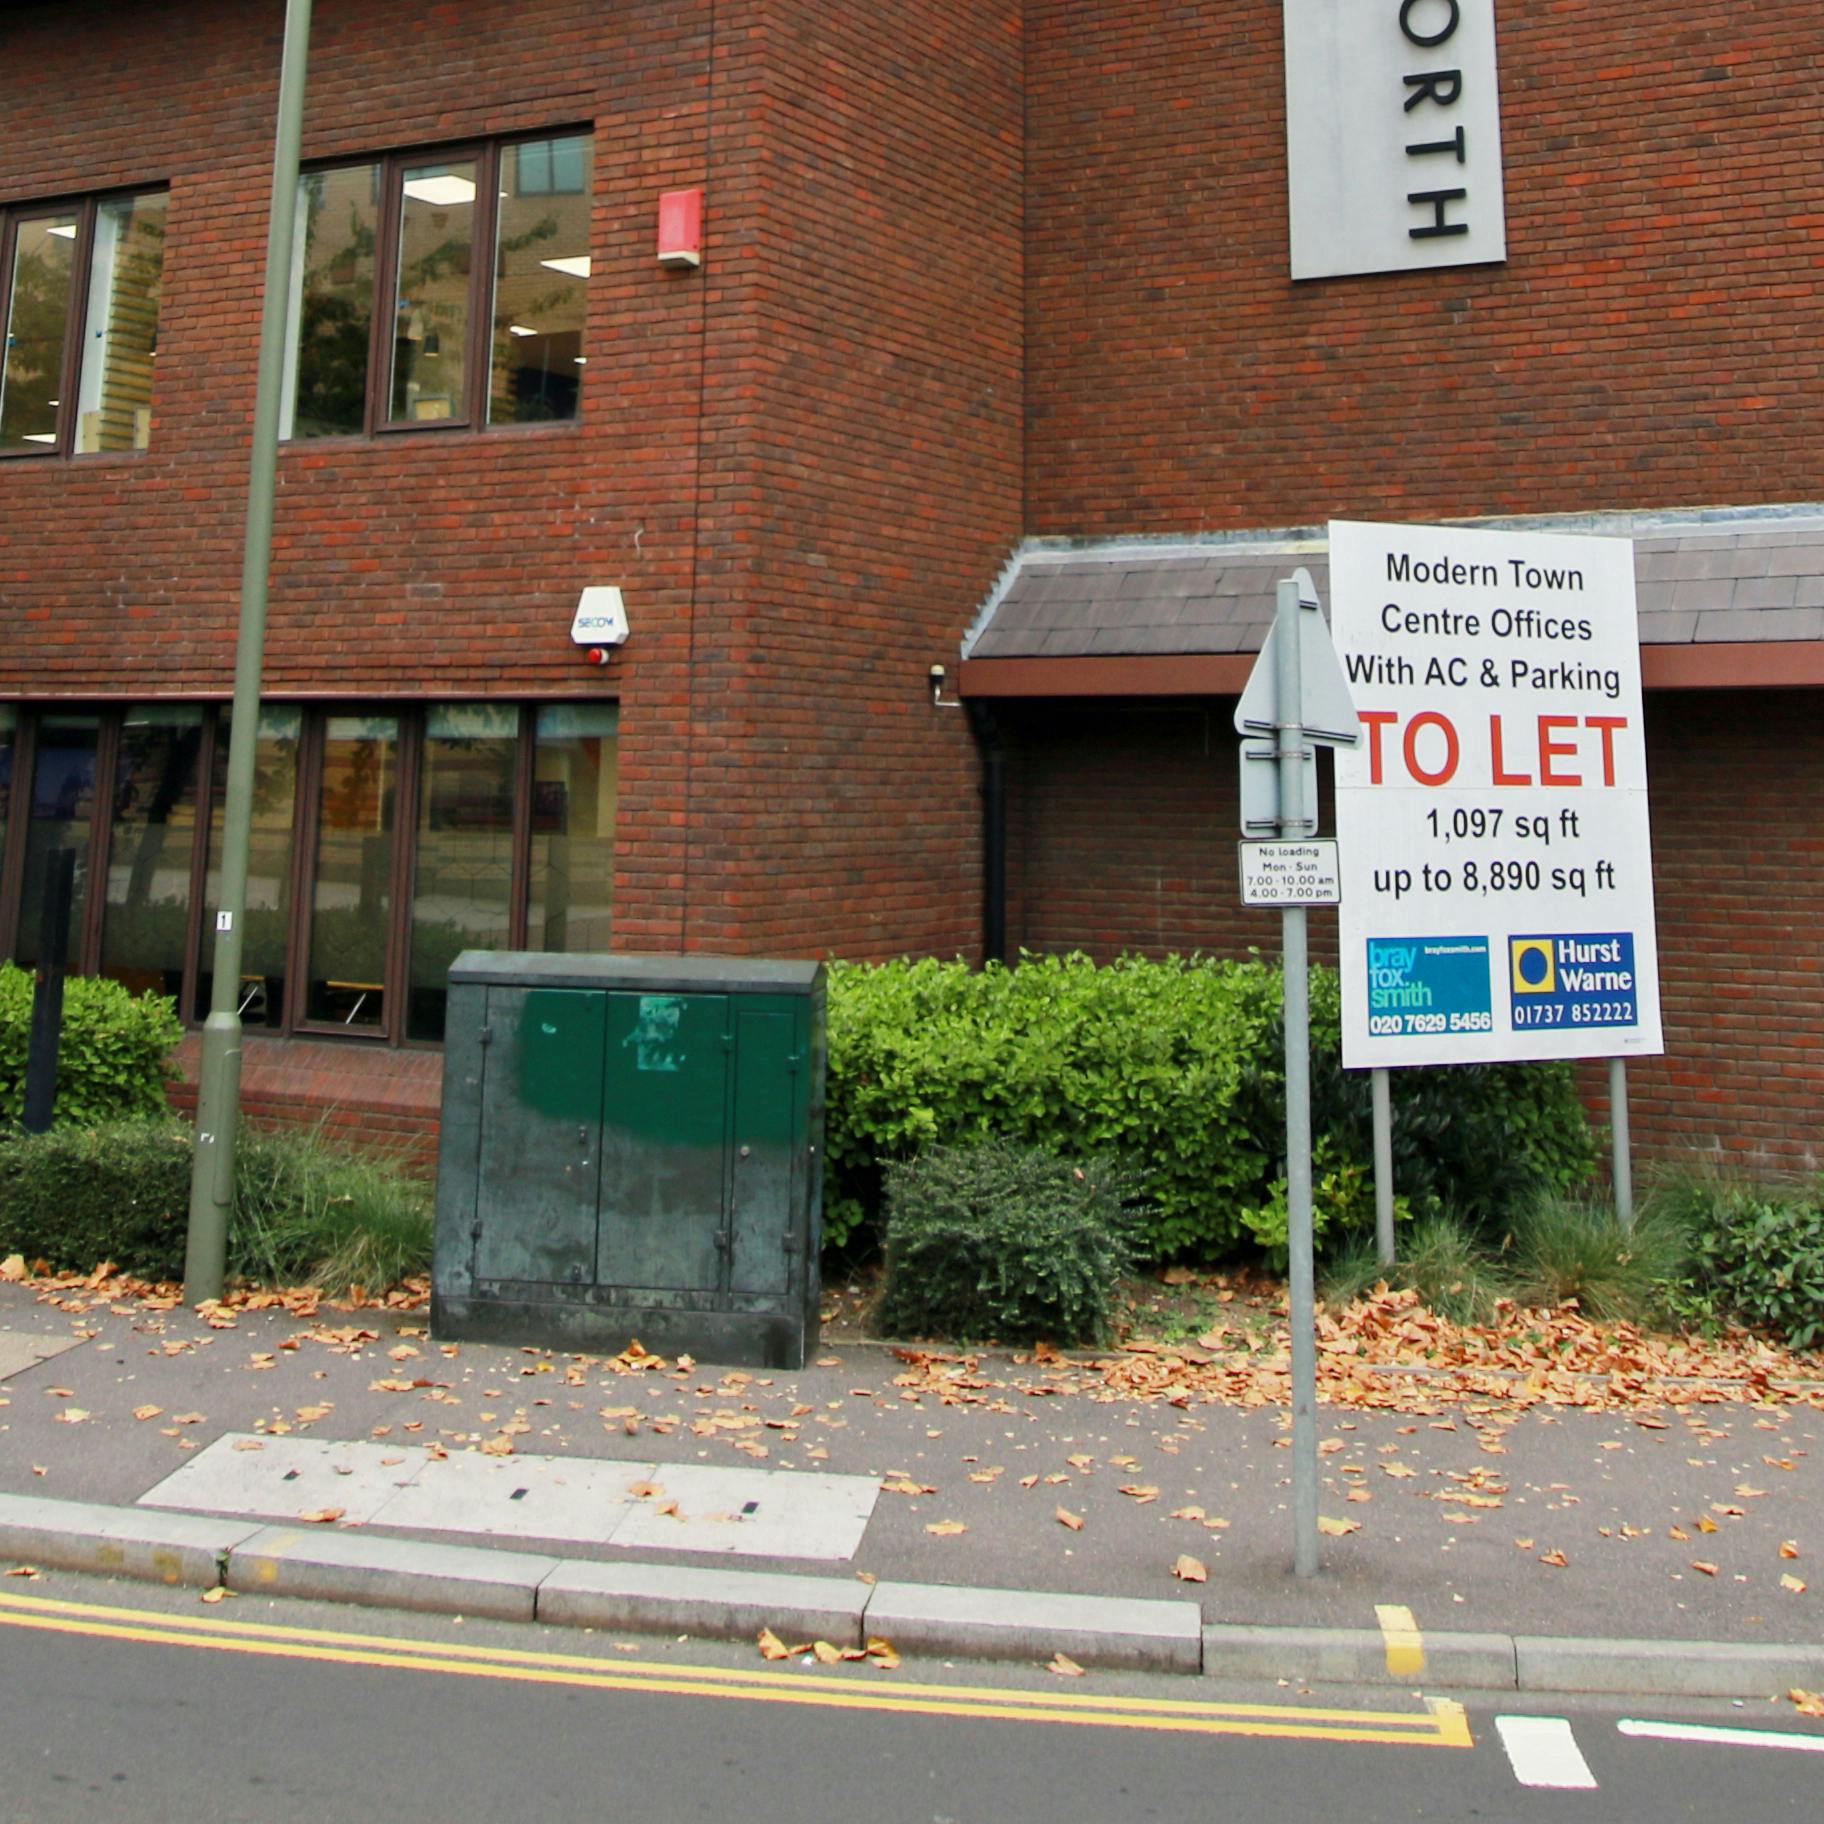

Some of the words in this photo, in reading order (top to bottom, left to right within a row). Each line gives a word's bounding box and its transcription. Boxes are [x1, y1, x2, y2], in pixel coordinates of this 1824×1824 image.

[1387, 554, 1497, 586] Modern
[1509, 560, 1583, 590] Town
[1382, 604, 1479, 636] Centre
[1492, 609, 1592, 640] Offices
[1346, 655, 1413, 684] With
[1425, 658, 1467, 686] AC
[1480, 659, 1499, 687] &
[1512, 660, 1619, 698] Parking
[1357, 711, 1460, 786] TO
[1489, 714, 1628, 787] LET
[1427, 809, 1503, 843] 1,097
[1516, 817, 1549, 845] sq
[1560, 809, 1579, 837] ft
[1259, 847, 1275, 856] No
[1279, 847, 1319, 857] loading
[1263, 862, 1286, 871] Mon
[1296, 861, 1318, 871] Sun
[1318, 876, 1334, 884] am
[1375, 870, 1411, 900] up
[1422, 864, 1451, 891] to
[1464, 861, 1540, 895] 8,890
[1552, 869, 1585, 897] sq
[1595, 860, 1615, 889] ft
[1369, 942, 1417, 973] bray
[1559, 940, 1620, 963] Hurst
[1560, 969, 1631, 991] Warne
[1371, 981, 1432, 1008] smith
[1371, 1016, 1402, 1033] 020
[1405, 1014, 1446, 1032] 7629
[1450, 1012, 1491, 1030] 5456
[1515, 1005, 1563, 1024] 01737
[1572, 1003, 1632, 1021] 852222
